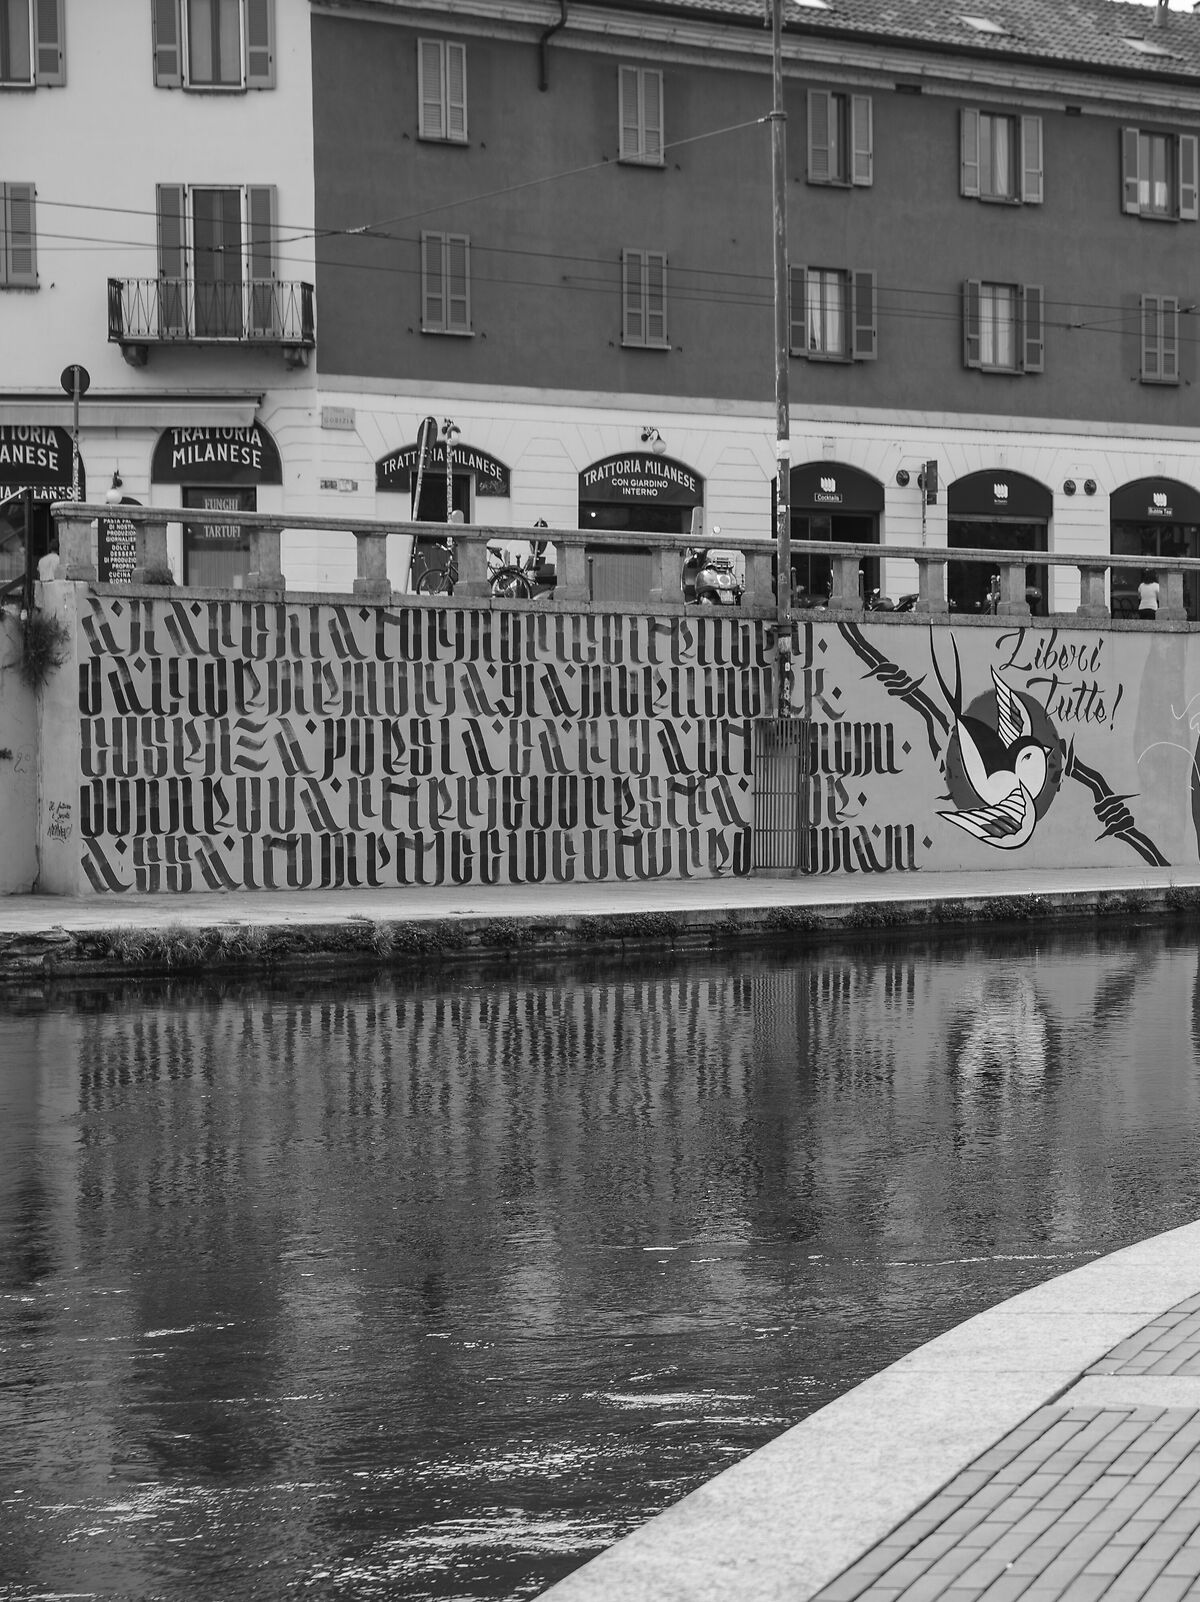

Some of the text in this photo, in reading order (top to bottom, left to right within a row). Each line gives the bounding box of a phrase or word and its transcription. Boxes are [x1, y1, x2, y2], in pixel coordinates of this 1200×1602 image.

[172, 443, 261, 469] MILANESE
[382, 447, 444, 475] TRATTIA
[583, 459, 696, 493] TRATTORIA MILANESE
[611, 478, 669, 489] CON GIARDINO
[622, 487, 658, 497] INTERNO
[203, 524, 241, 538] TARTUFI
